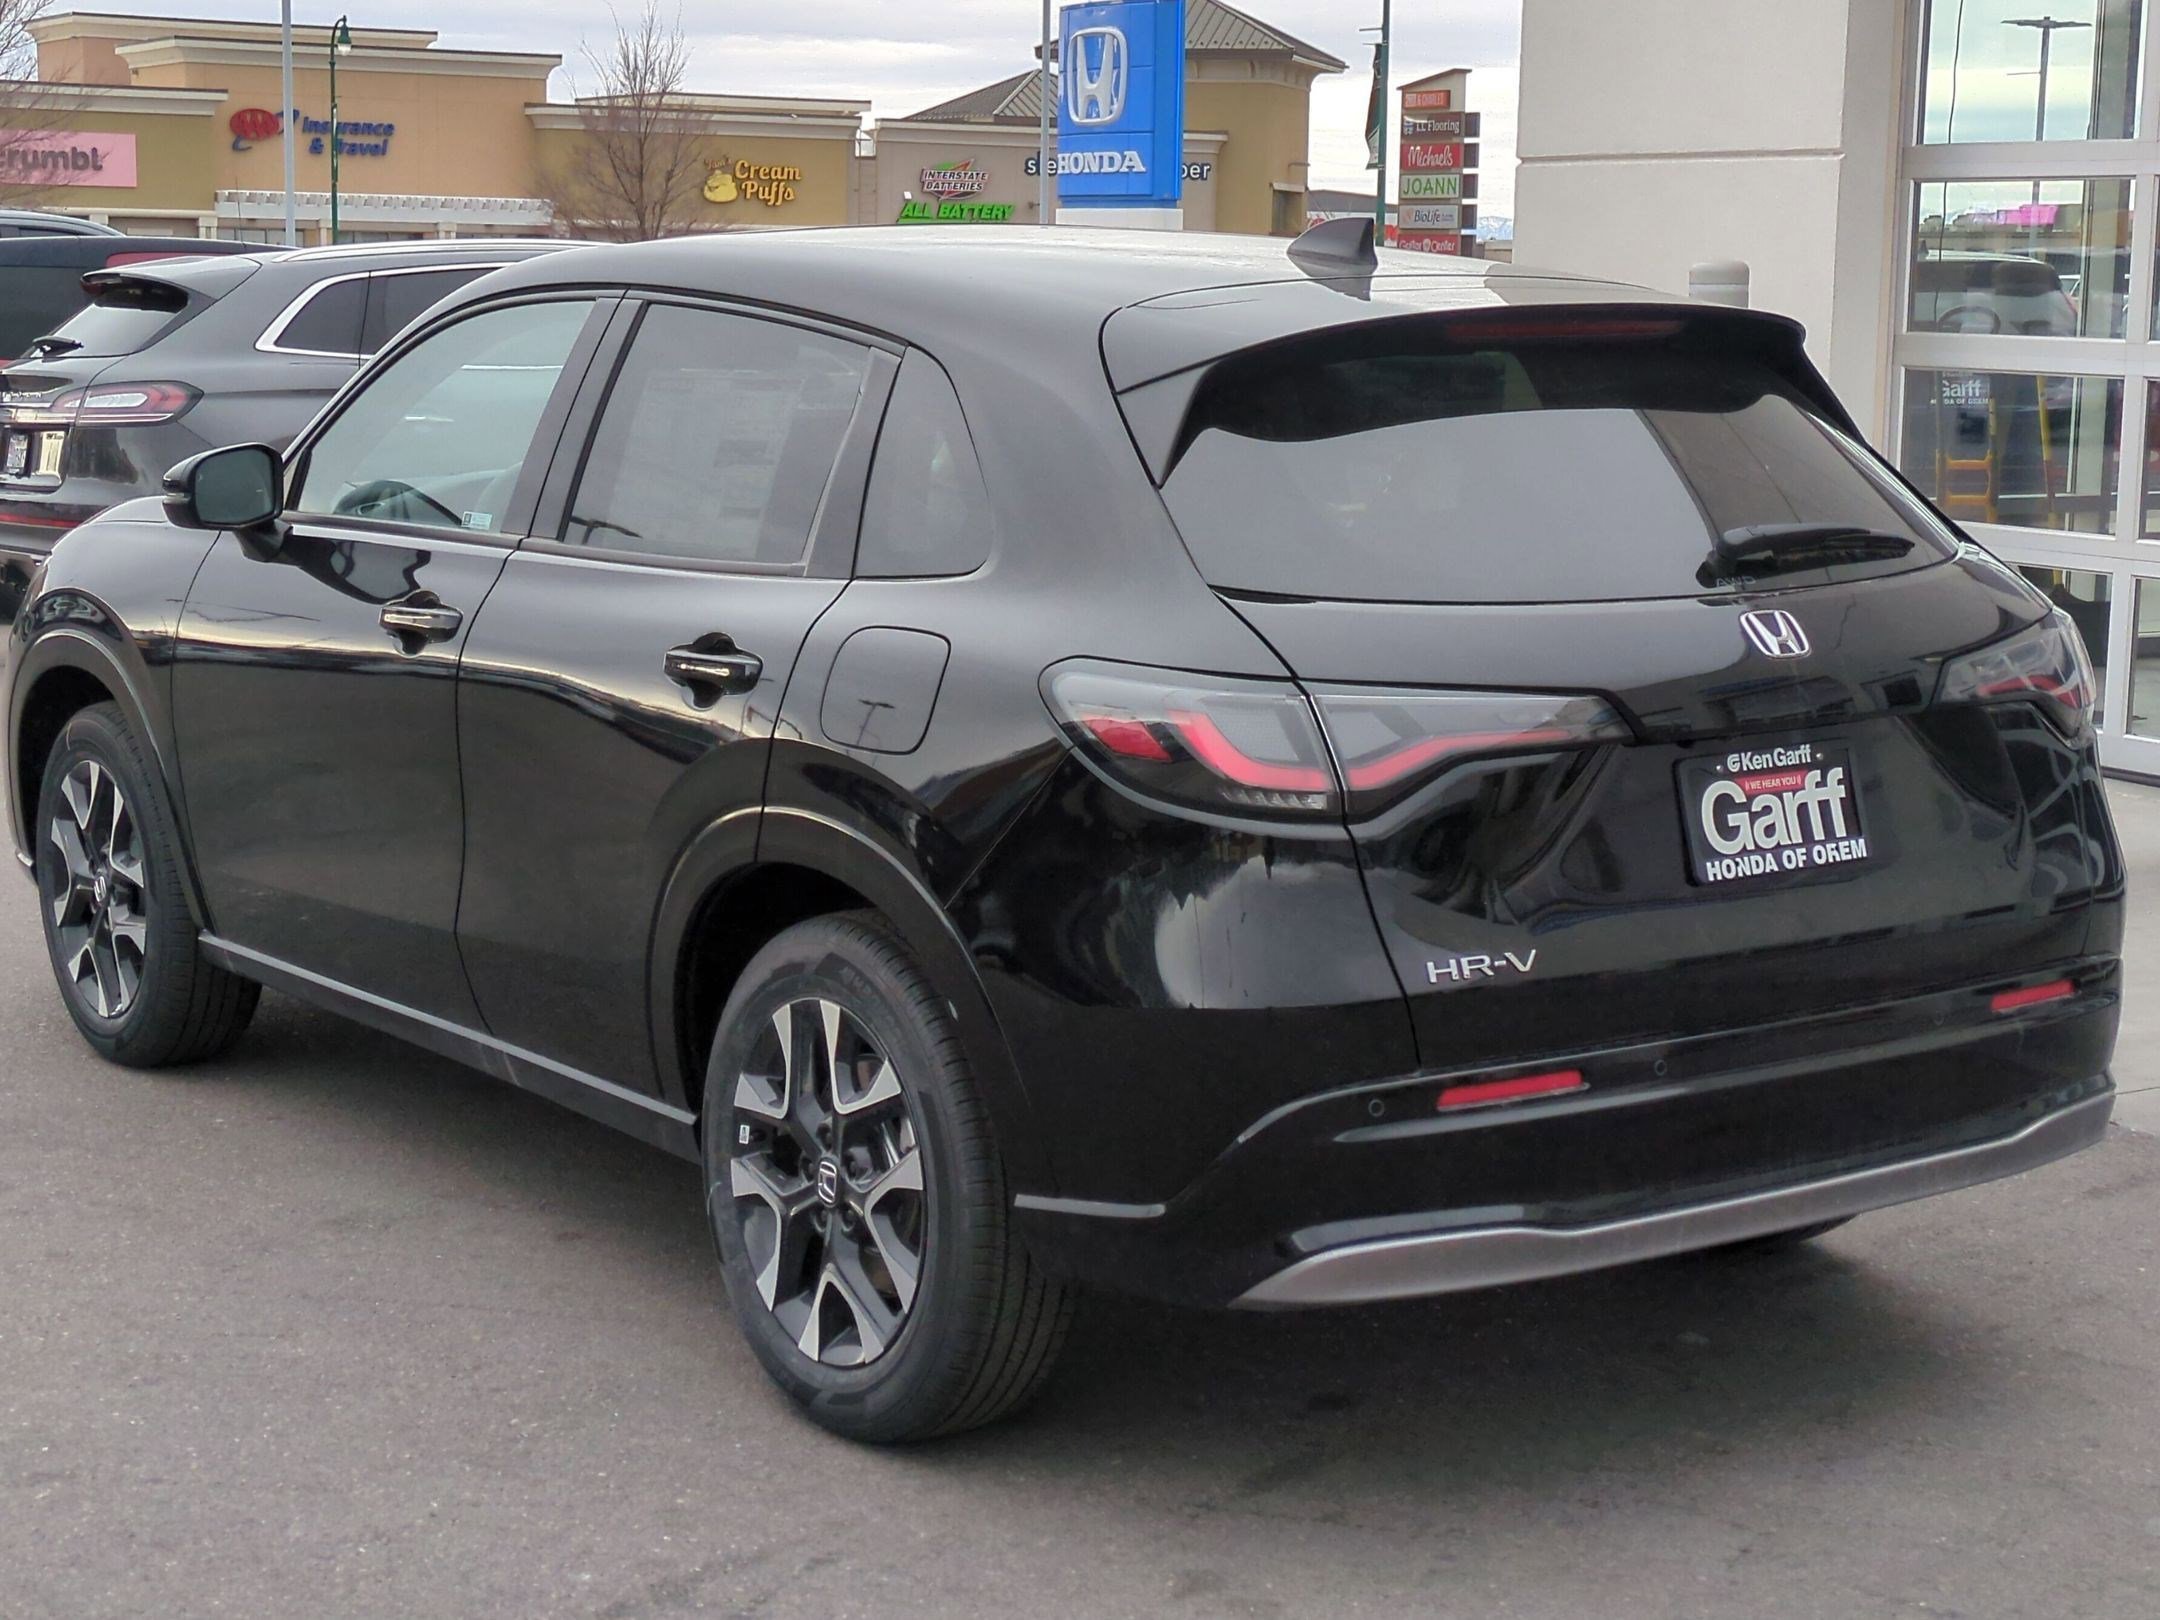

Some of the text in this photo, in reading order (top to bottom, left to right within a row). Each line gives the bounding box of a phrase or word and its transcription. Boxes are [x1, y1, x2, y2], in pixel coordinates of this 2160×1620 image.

[302, 116, 395, 137] Insrance
[1428, 120, 1460, 134] Flooring
[309, 137, 324, 154] &
[1057, 151, 1146, 174] HONDA
[1408, 145, 1453, 167] Michaels
[734, 159, 801, 179] Cream
[924, 170, 988, 181] INTERSTATE
[741, 181, 795, 206] Puffs
[925, 181, 983, 191] BATTERIES
[1403, 177, 1457, 195] JOANN
[900, 202, 1016, 219] ALL BATTERY
[1414, 209, 1440, 225] BioLife
[1749, 775, 1797, 790] WE HEAR YOU
[1701, 767, 1847, 855] Garff
[1706, 838, 1868, 881] HONDA OF OREM
[1426, 949, 1537, 983] HR-V
